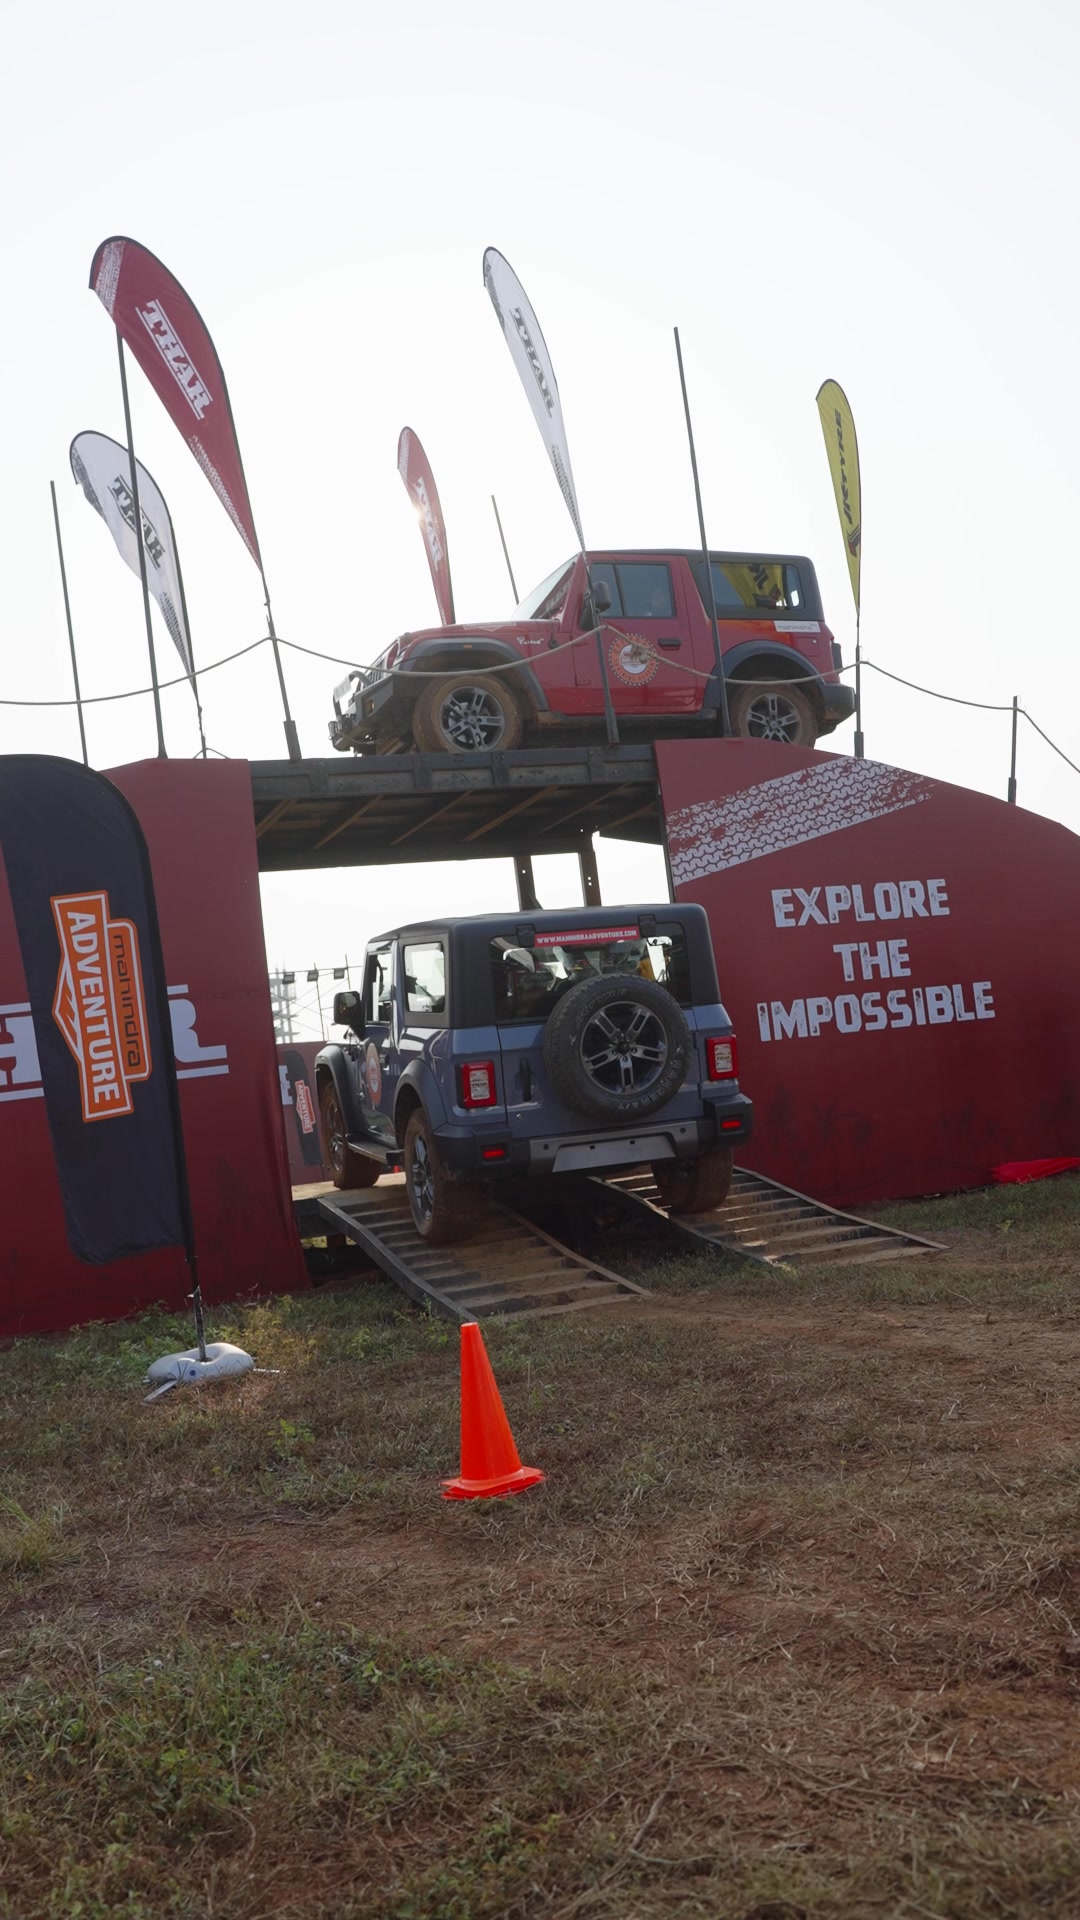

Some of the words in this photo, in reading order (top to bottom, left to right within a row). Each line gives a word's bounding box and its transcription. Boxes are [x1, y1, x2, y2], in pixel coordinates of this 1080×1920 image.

[140, 299, 211, 420] THAR
[509, 306, 554, 417] THAR
[536, 929, 637, 944] WWW.MAHINDRAADVENTURE.COM
[771, 878, 950, 928] EXPLORE
[112, 934, 141, 1068] mahindra
[833, 938, 911, 982] THE
[66, 911, 120, 1104] ADVENTURE
[757, 981, 996, 1042] IMPOSSIBLE
